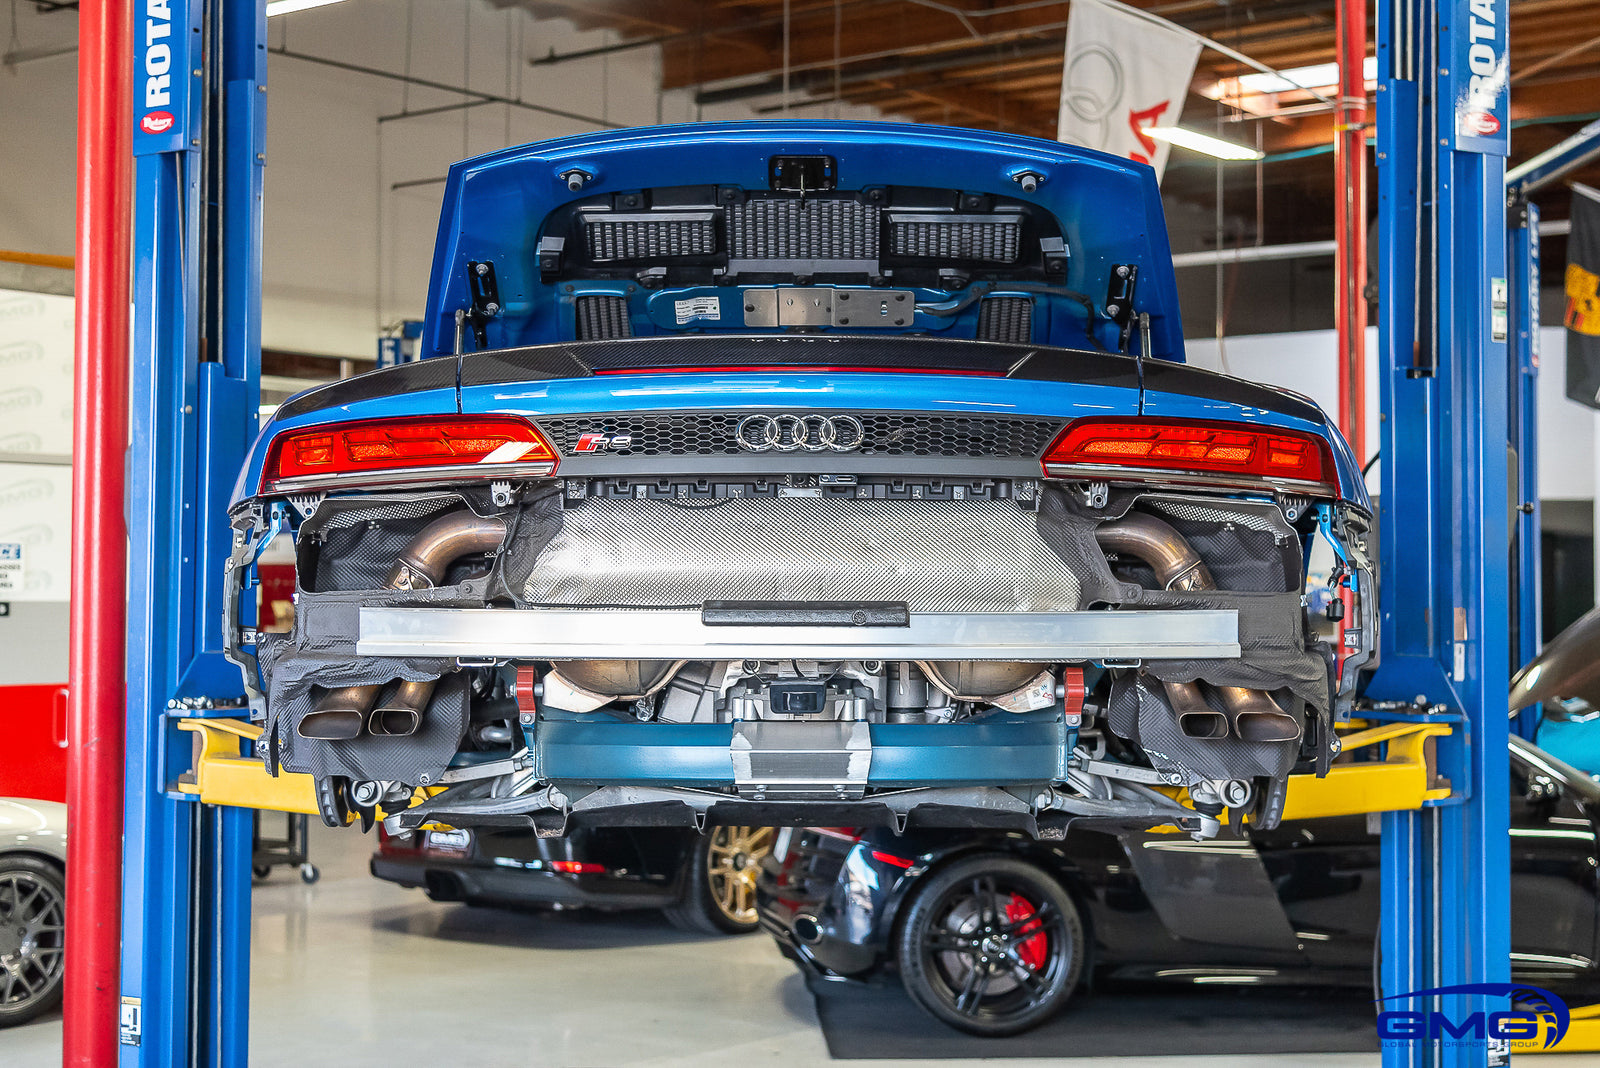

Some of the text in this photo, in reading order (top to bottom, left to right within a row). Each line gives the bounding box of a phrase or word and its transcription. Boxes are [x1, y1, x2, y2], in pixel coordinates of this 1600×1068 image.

[145, 0, 171, 108] ROTA
[1469, 0, 1496, 109] ROTA
[579, 434, 632, 452] R8
